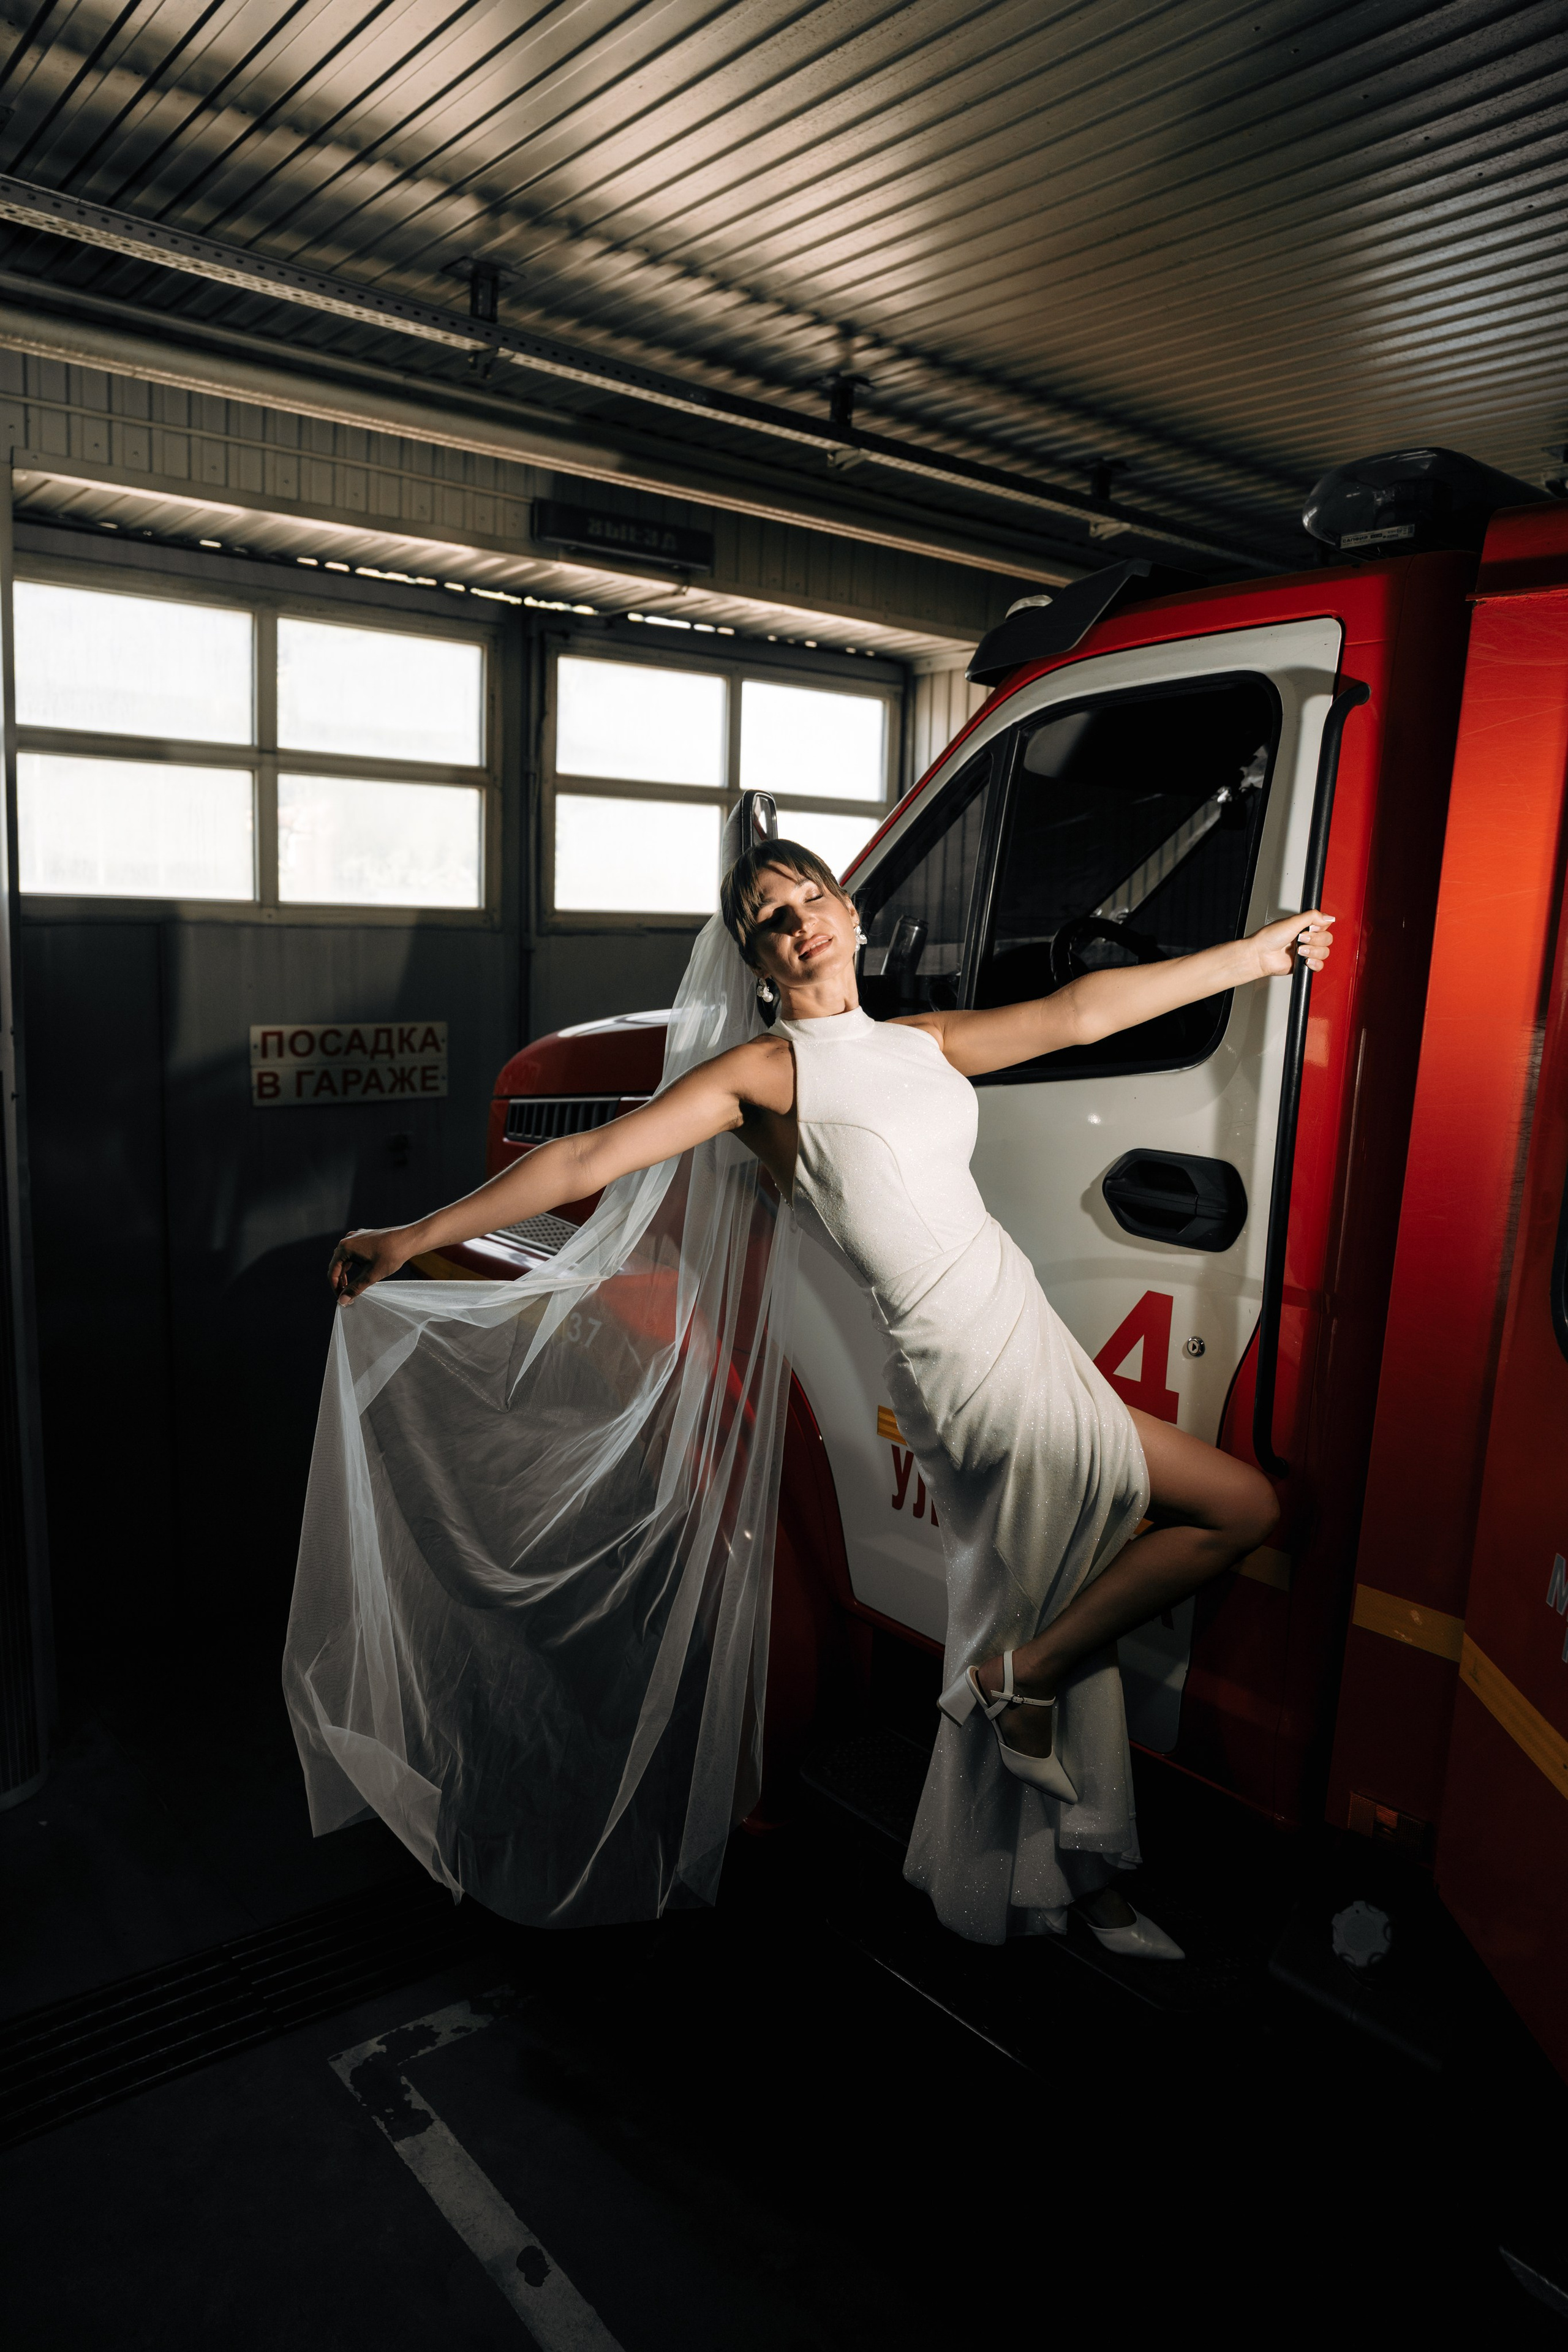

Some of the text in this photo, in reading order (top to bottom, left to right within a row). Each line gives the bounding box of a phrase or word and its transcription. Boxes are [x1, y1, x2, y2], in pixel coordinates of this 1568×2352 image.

[261, 1027, 442, 1060] ПОСАДКА
[257, 1066, 440, 1099] В ГАРАЖЕ
[567, 1312, 601, 1348] 37
